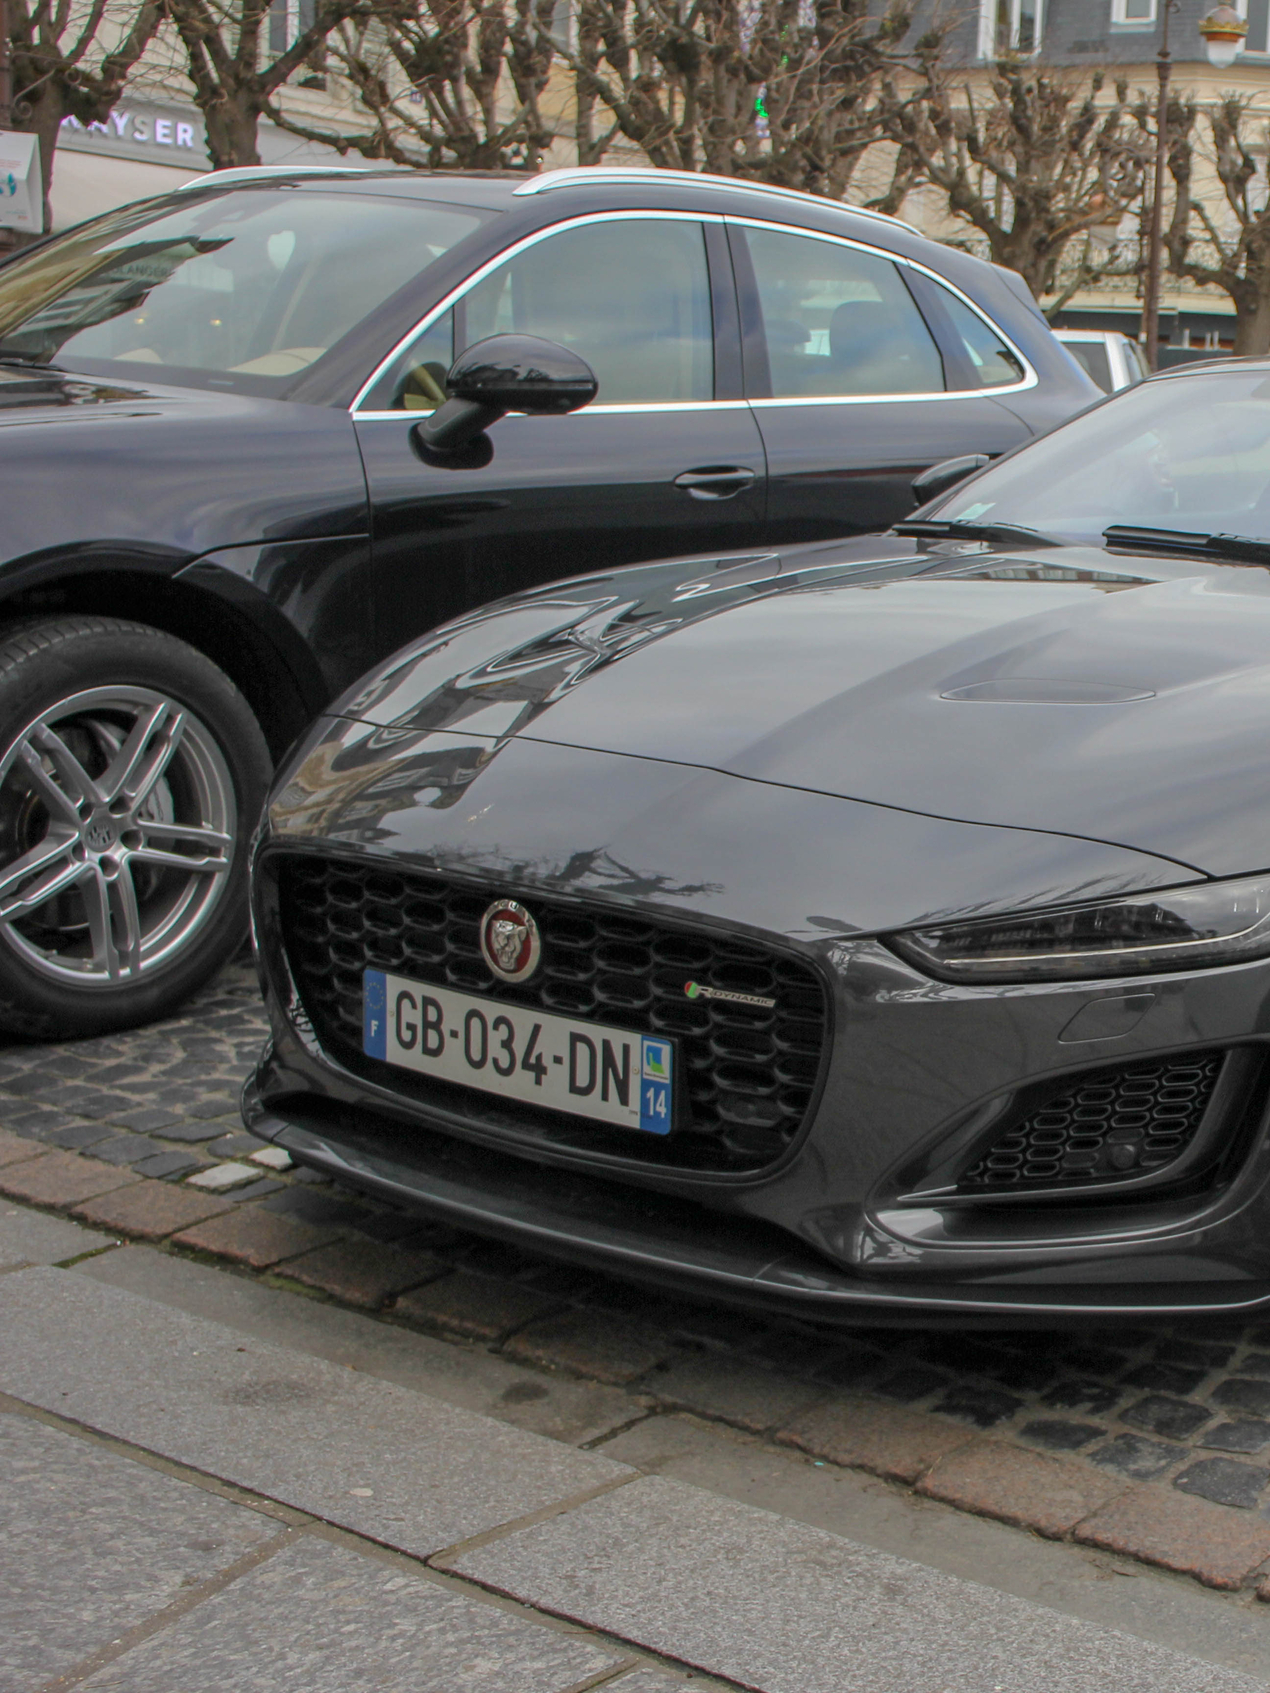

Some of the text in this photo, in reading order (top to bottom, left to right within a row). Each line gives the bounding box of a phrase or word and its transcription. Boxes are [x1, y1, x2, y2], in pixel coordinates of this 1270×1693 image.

[711, 989, 774, 1007] DYNAMIC
[370, 1019, 379, 1037] F
[395, 989, 631, 1108] GB-034-DN
[646, 1086, 668, 1119] 14
